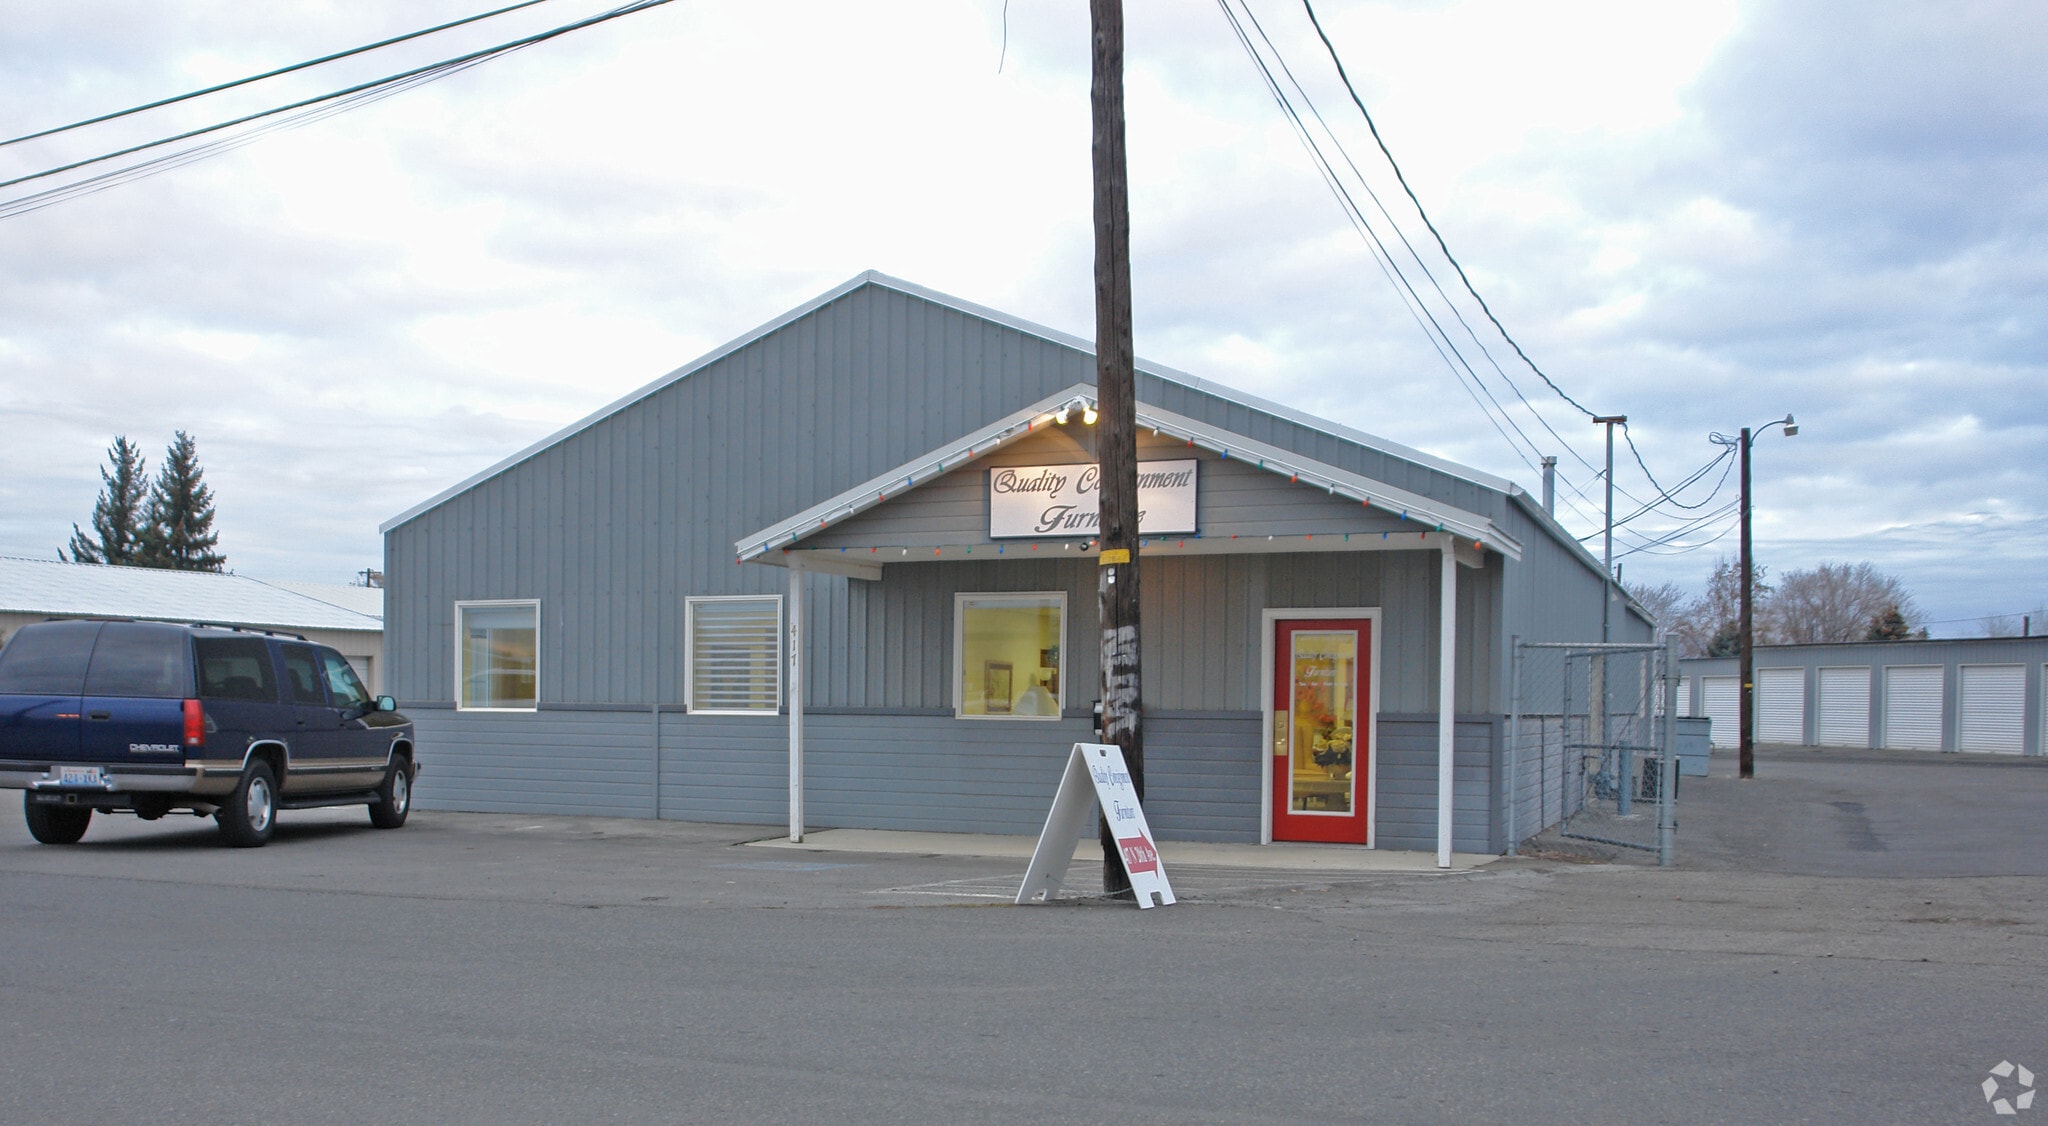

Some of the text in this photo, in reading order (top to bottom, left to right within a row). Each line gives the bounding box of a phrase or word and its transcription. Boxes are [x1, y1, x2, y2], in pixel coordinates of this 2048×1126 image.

[993, 466, 1194, 499] Quality Conment
[1034, 504, 1147, 533] Furne
[790, 624, 798, 667] 417
[129, 743, 180, 752] CHEVROLET
